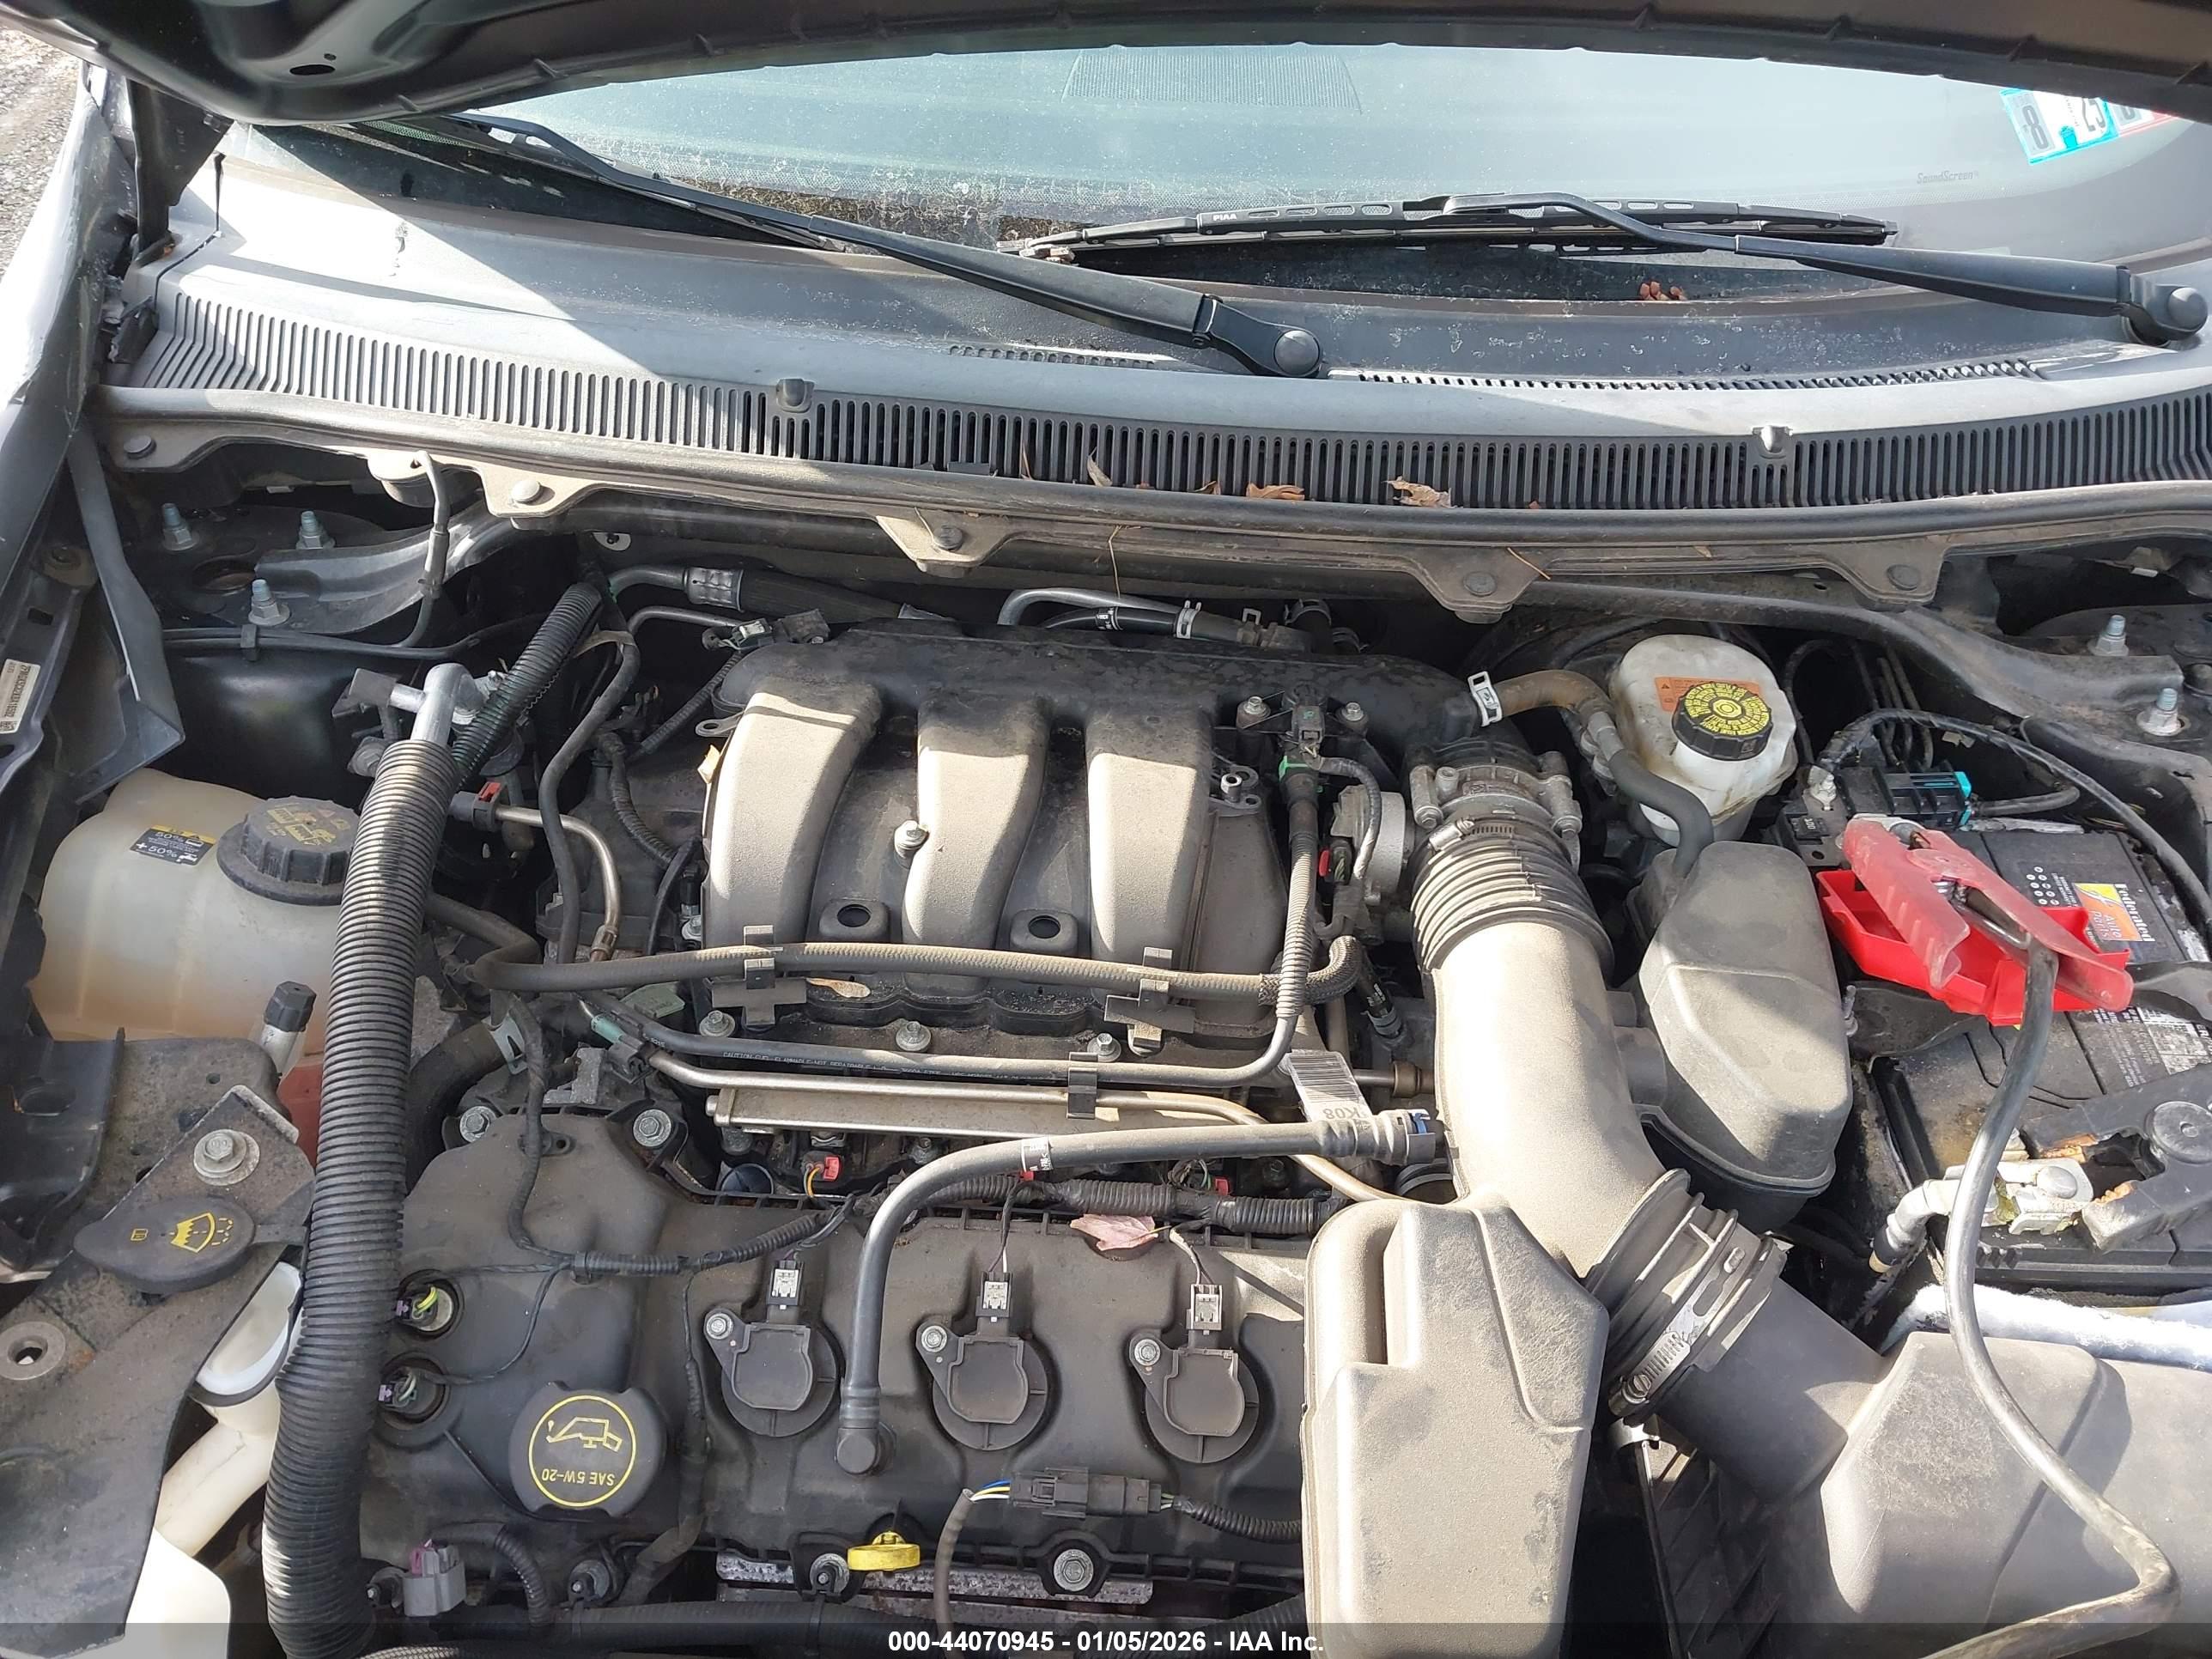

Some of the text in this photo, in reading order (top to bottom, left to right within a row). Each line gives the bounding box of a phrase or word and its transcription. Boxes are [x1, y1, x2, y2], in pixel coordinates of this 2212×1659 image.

[2021, 105, 2049, 149] 8
[1212, 213, 1237, 222] PIAA
[2113, 884, 2155, 942] Federated
[2103, 914, 2122, 939] Auto
[1322, 1107, 1361, 1120] K08
[541, 1468, 616, 1486] SAE 5W-20
